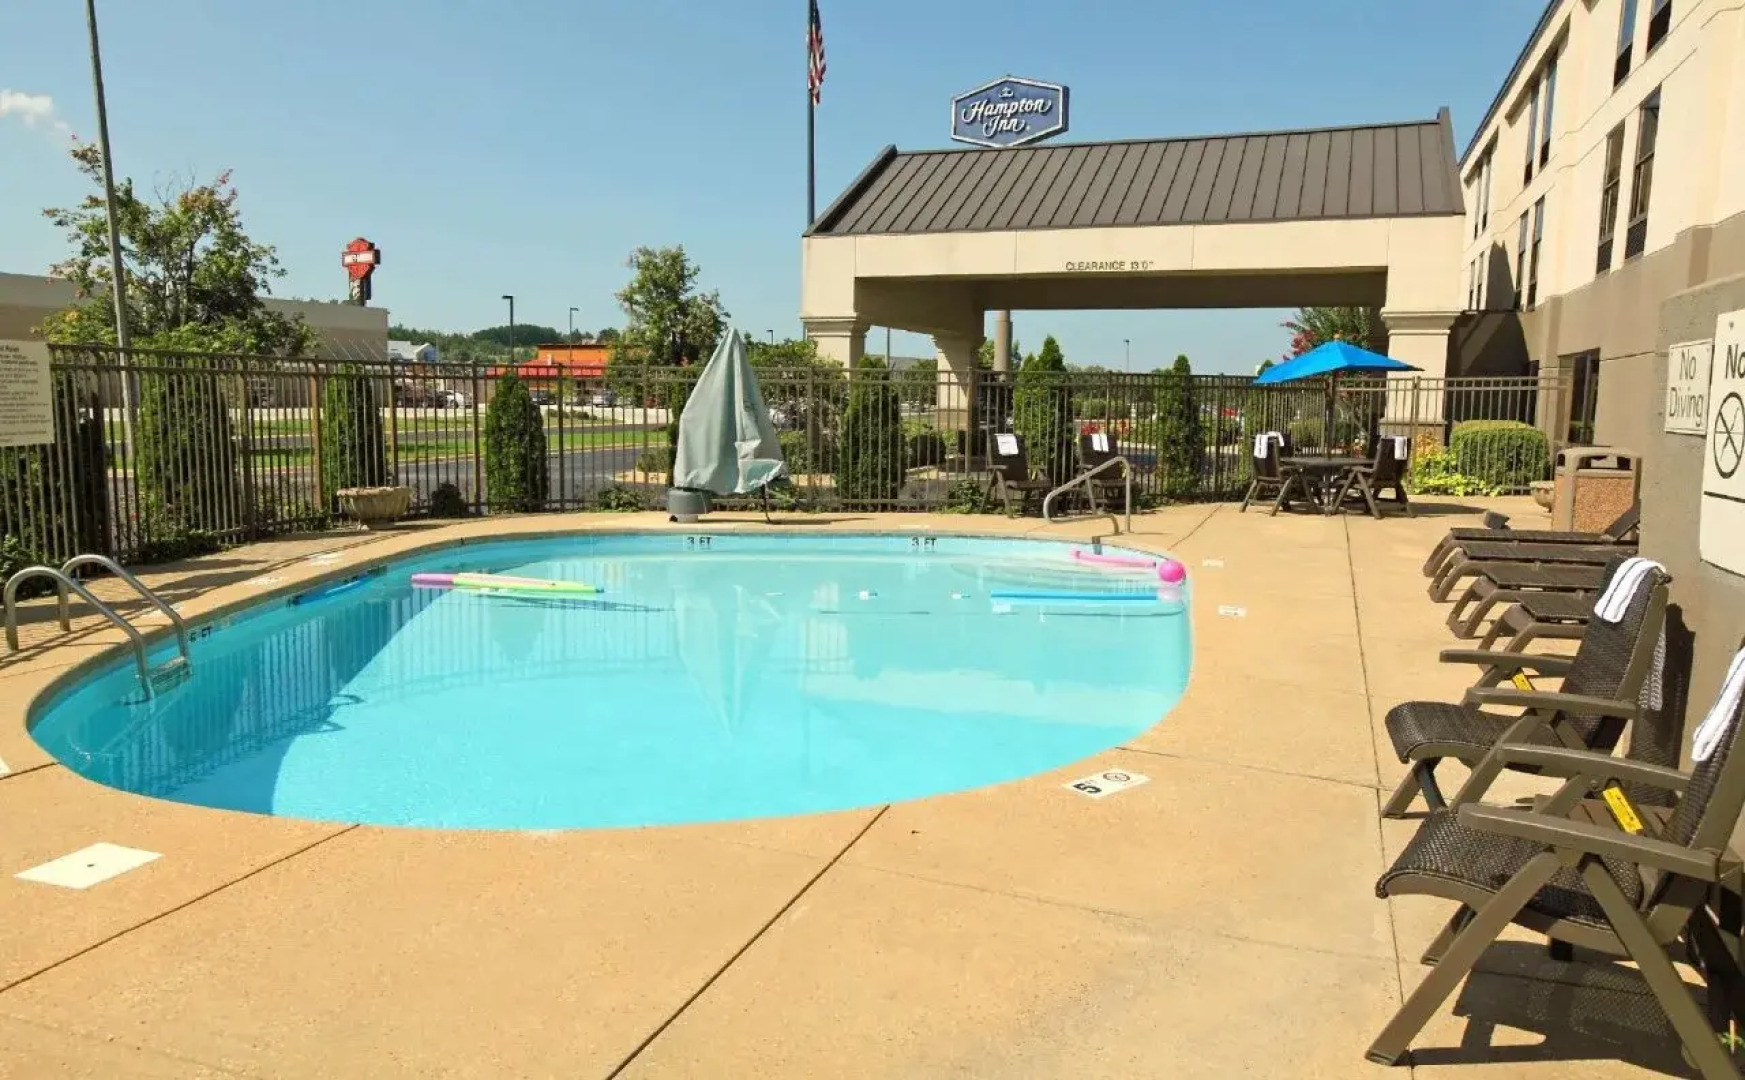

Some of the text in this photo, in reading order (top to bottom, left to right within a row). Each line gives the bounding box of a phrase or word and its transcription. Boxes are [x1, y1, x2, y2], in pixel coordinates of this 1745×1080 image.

[961, 98, 1052, 123] Hampton
[982, 115, 1025, 137] Inn
[1065, 261, 1125, 271] CLEARANCE
[1680, 348, 1697, 380] No
[1669, 386, 1704, 427] Diving
[686, 536, 712, 545] 3 FT
[911, 536, 937, 546] 3 FT
